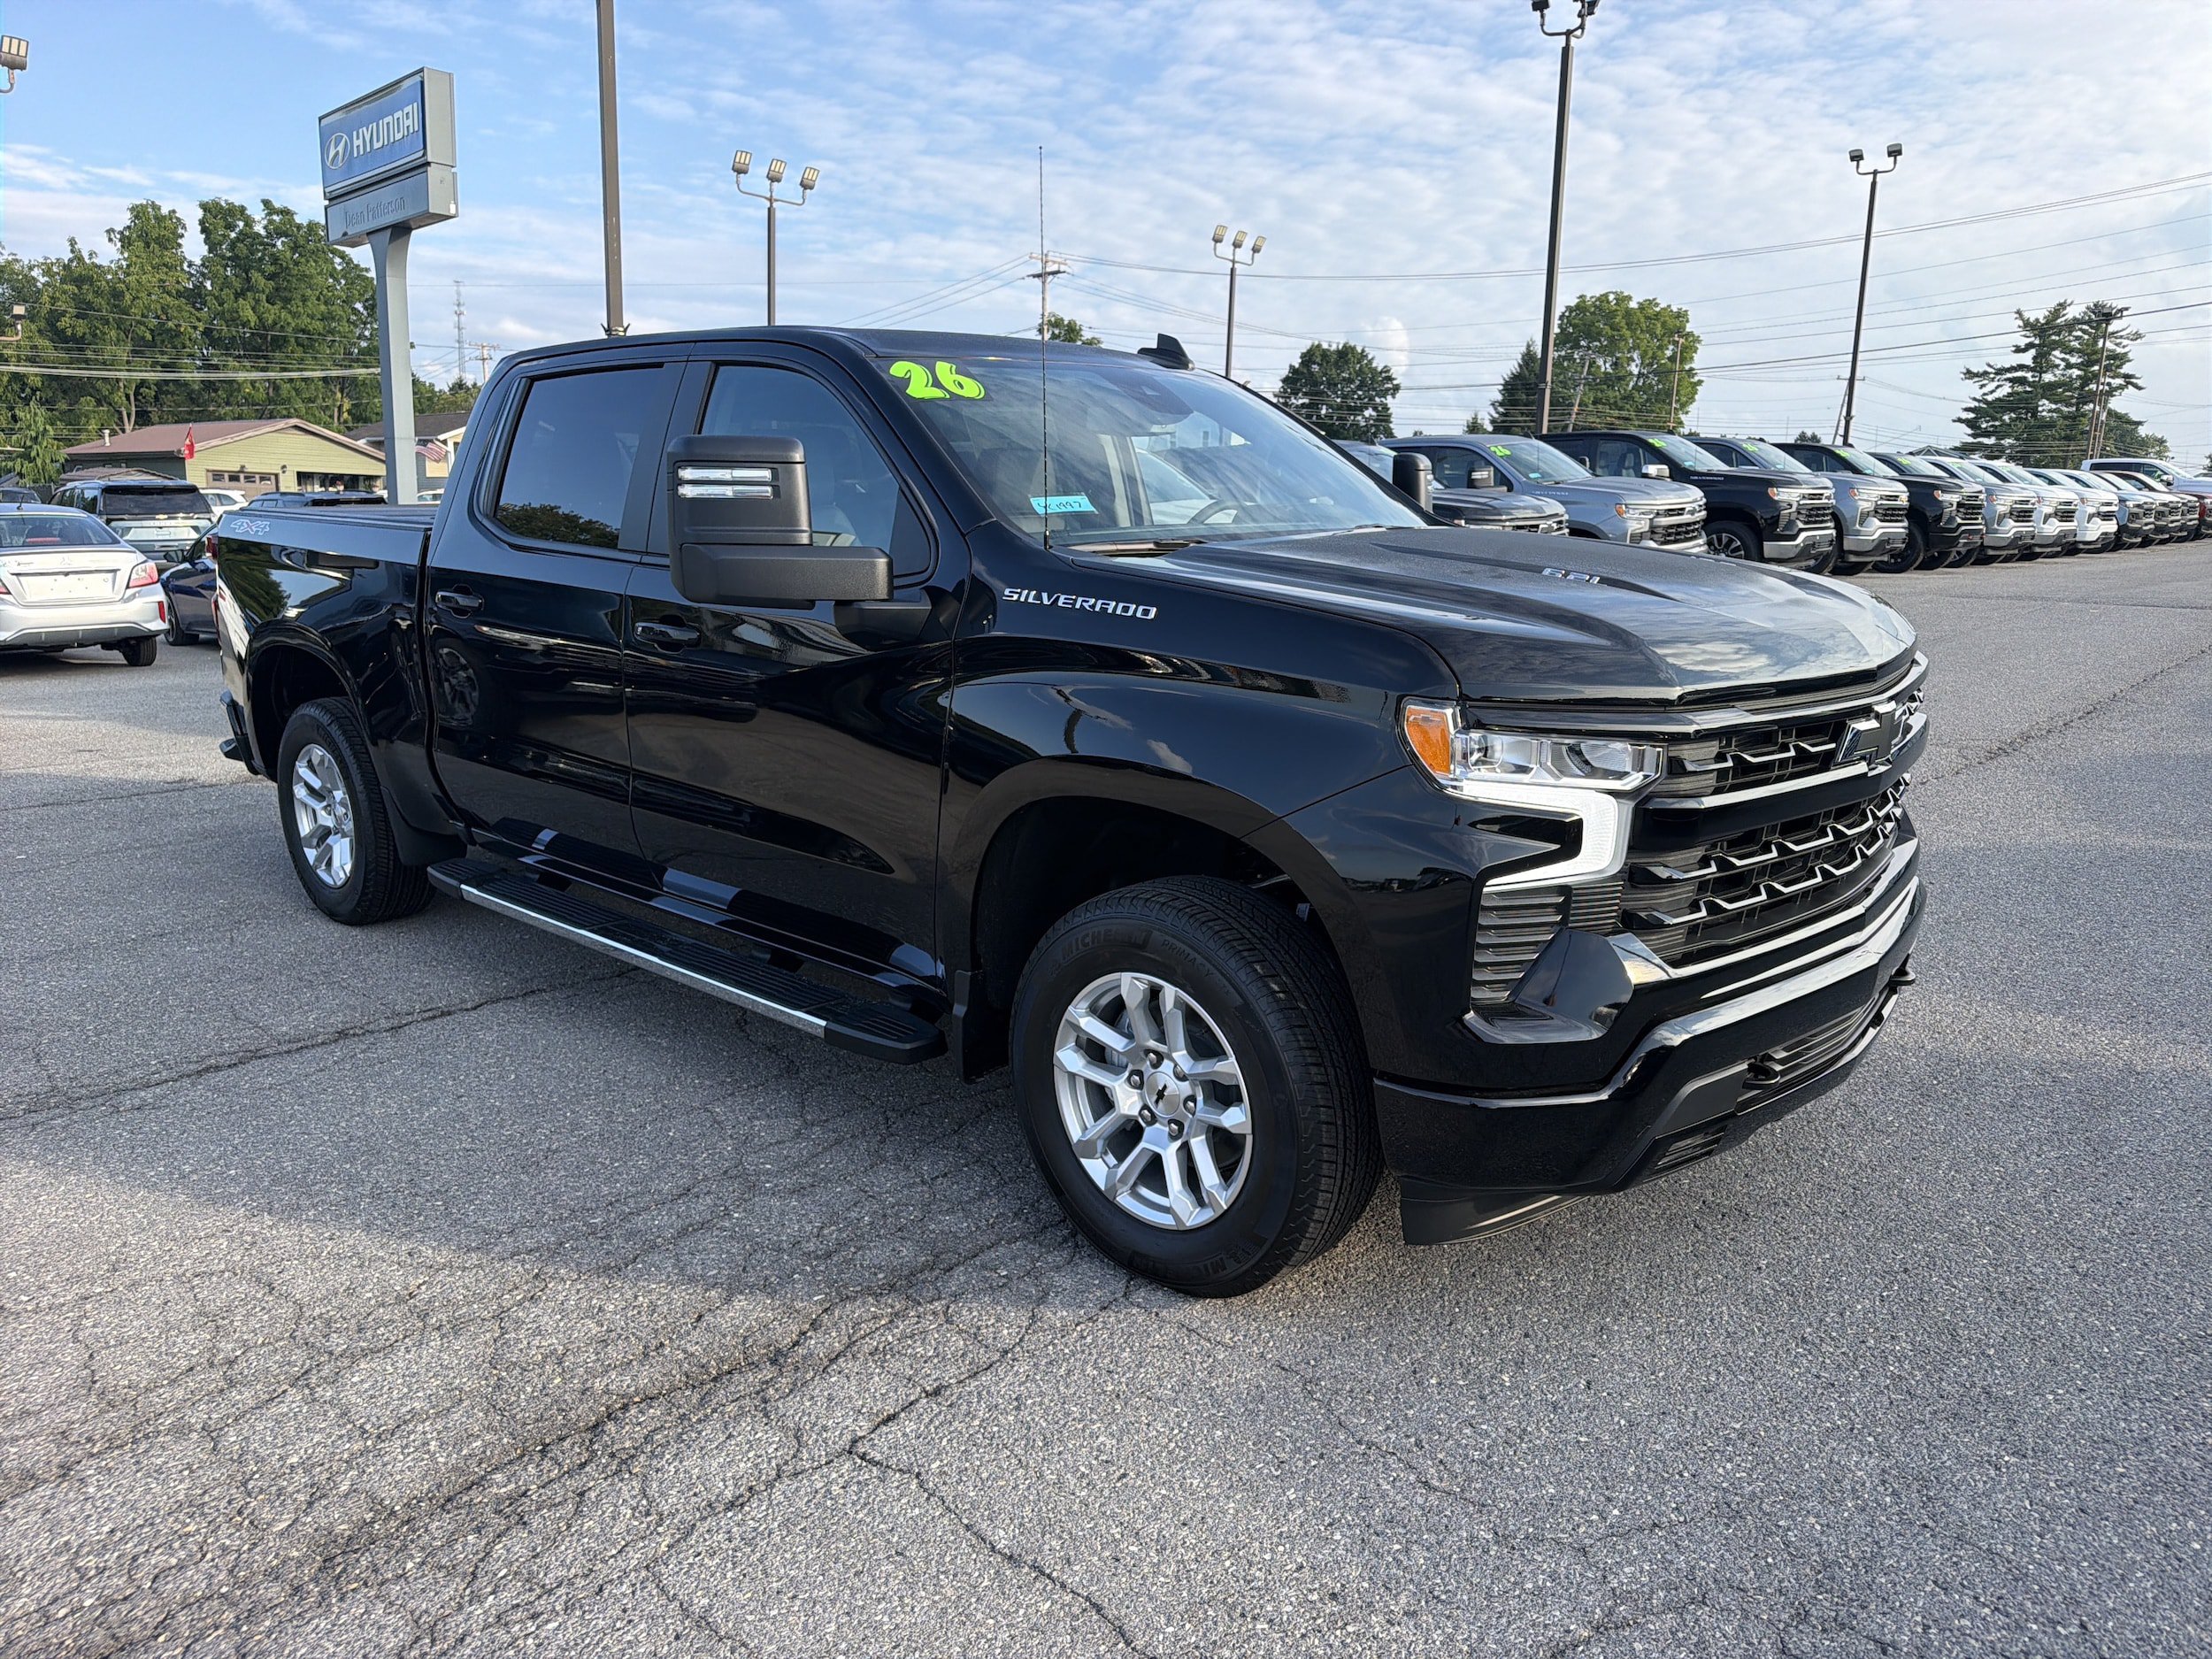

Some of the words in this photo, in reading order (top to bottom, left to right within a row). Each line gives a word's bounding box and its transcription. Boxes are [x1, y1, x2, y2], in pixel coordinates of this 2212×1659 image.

[352, 102, 419, 158] HYUNDAI
[344, 211, 365, 230] Dean
[366, 196, 406, 223] Patterson
[888, 360, 986, 399] 26
[1489, 445, 1512, 457] 26
[1002, 587, 1157, 620] SILVERADO
